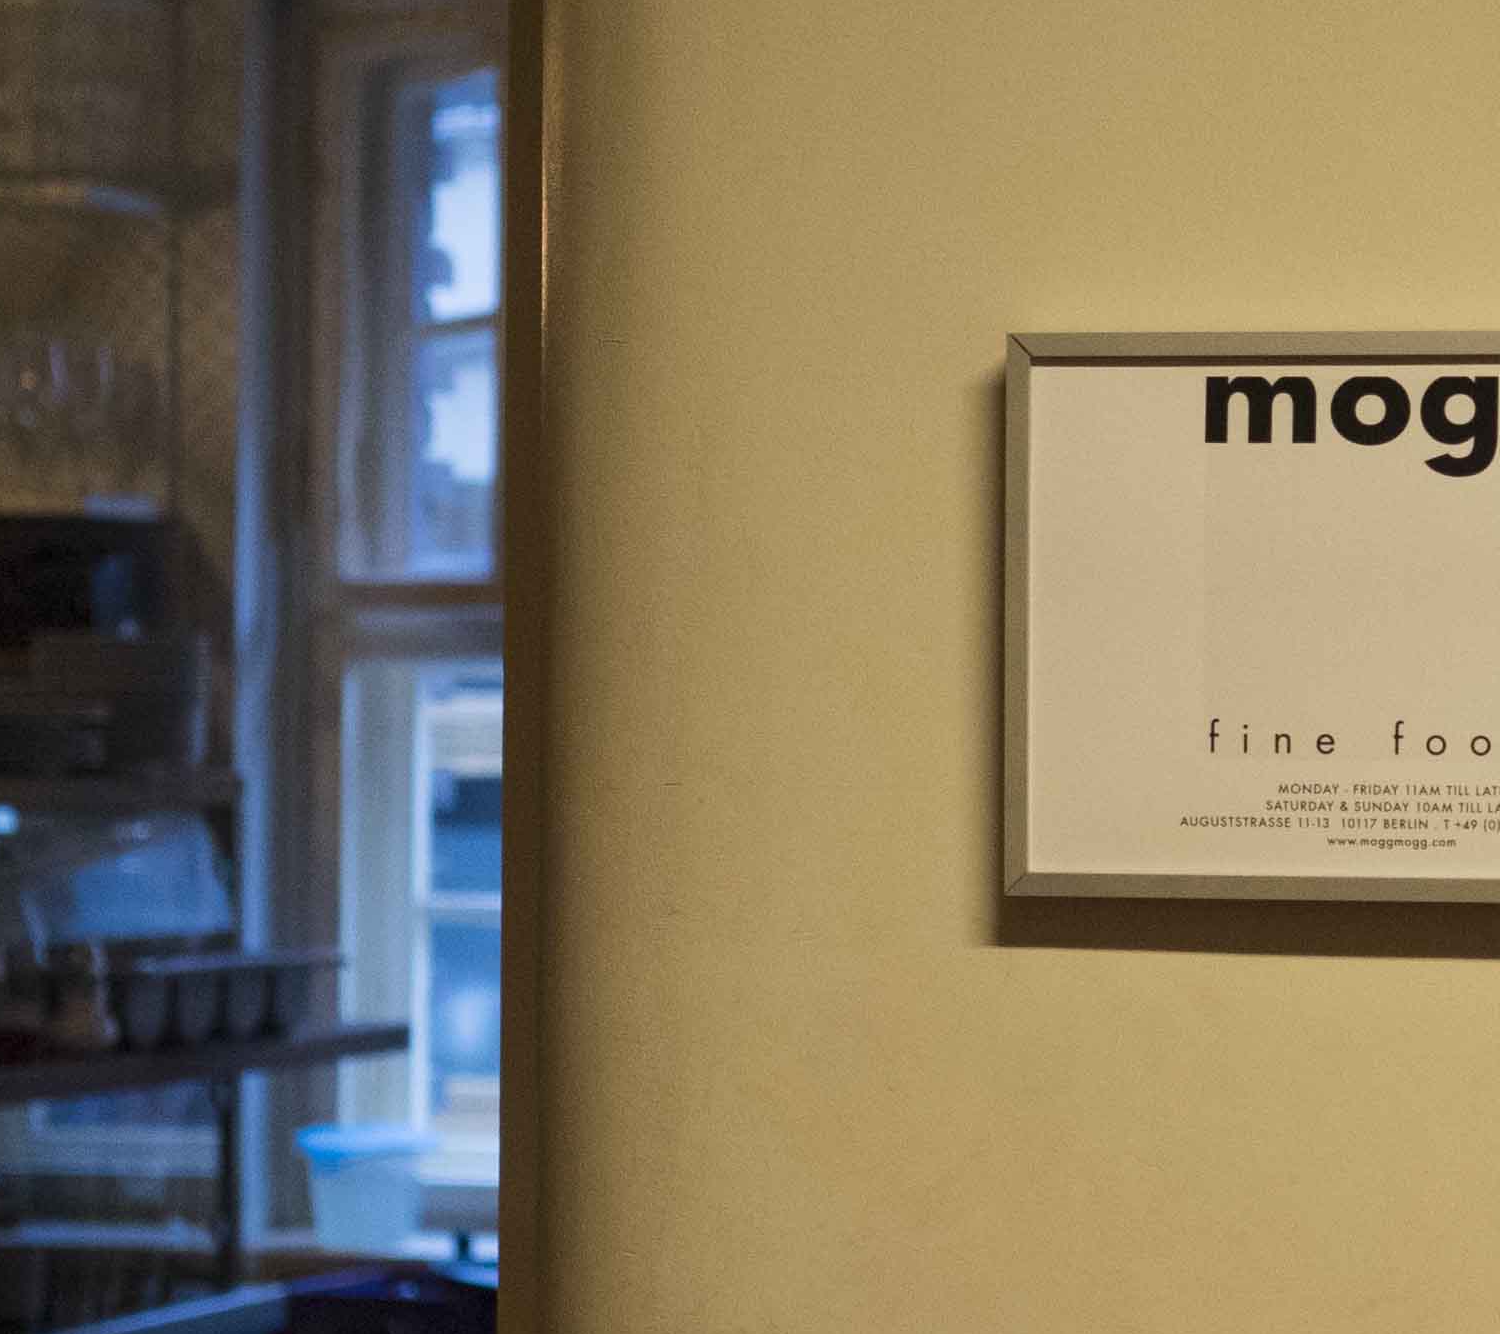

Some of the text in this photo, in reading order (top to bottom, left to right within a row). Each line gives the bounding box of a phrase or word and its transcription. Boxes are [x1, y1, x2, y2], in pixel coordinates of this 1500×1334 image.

[1208, 717, 1336, 756] fine
[1277, 782, 1339, 795] MONDAY
[1352, 783, 1399, 796] FRIDAY
[1406, 784, 1441, 795] 11AM
[1446, 784, 1470, 797] TILL
[1265, 799, 1334, 812] SATURDAY
[1339, 800, 1349, 812] &
[1354, 800, 1409, 813] SUNDAY
[1416, 801, 1453, 813] 10AM
[1458, 801, 1483, 814] TILL
[1179, 815, 1291, 829] AUGUSTSTRASSE
[1297, 816, 1330, 830] 11-13
[1341, 817, 1378, 830] 10117
[1382, 818, 1429, 830] BERLIN
[1455, 819, 1478, 830] +49
[1326, 836, 1457, 851] www.moggmogg.com
